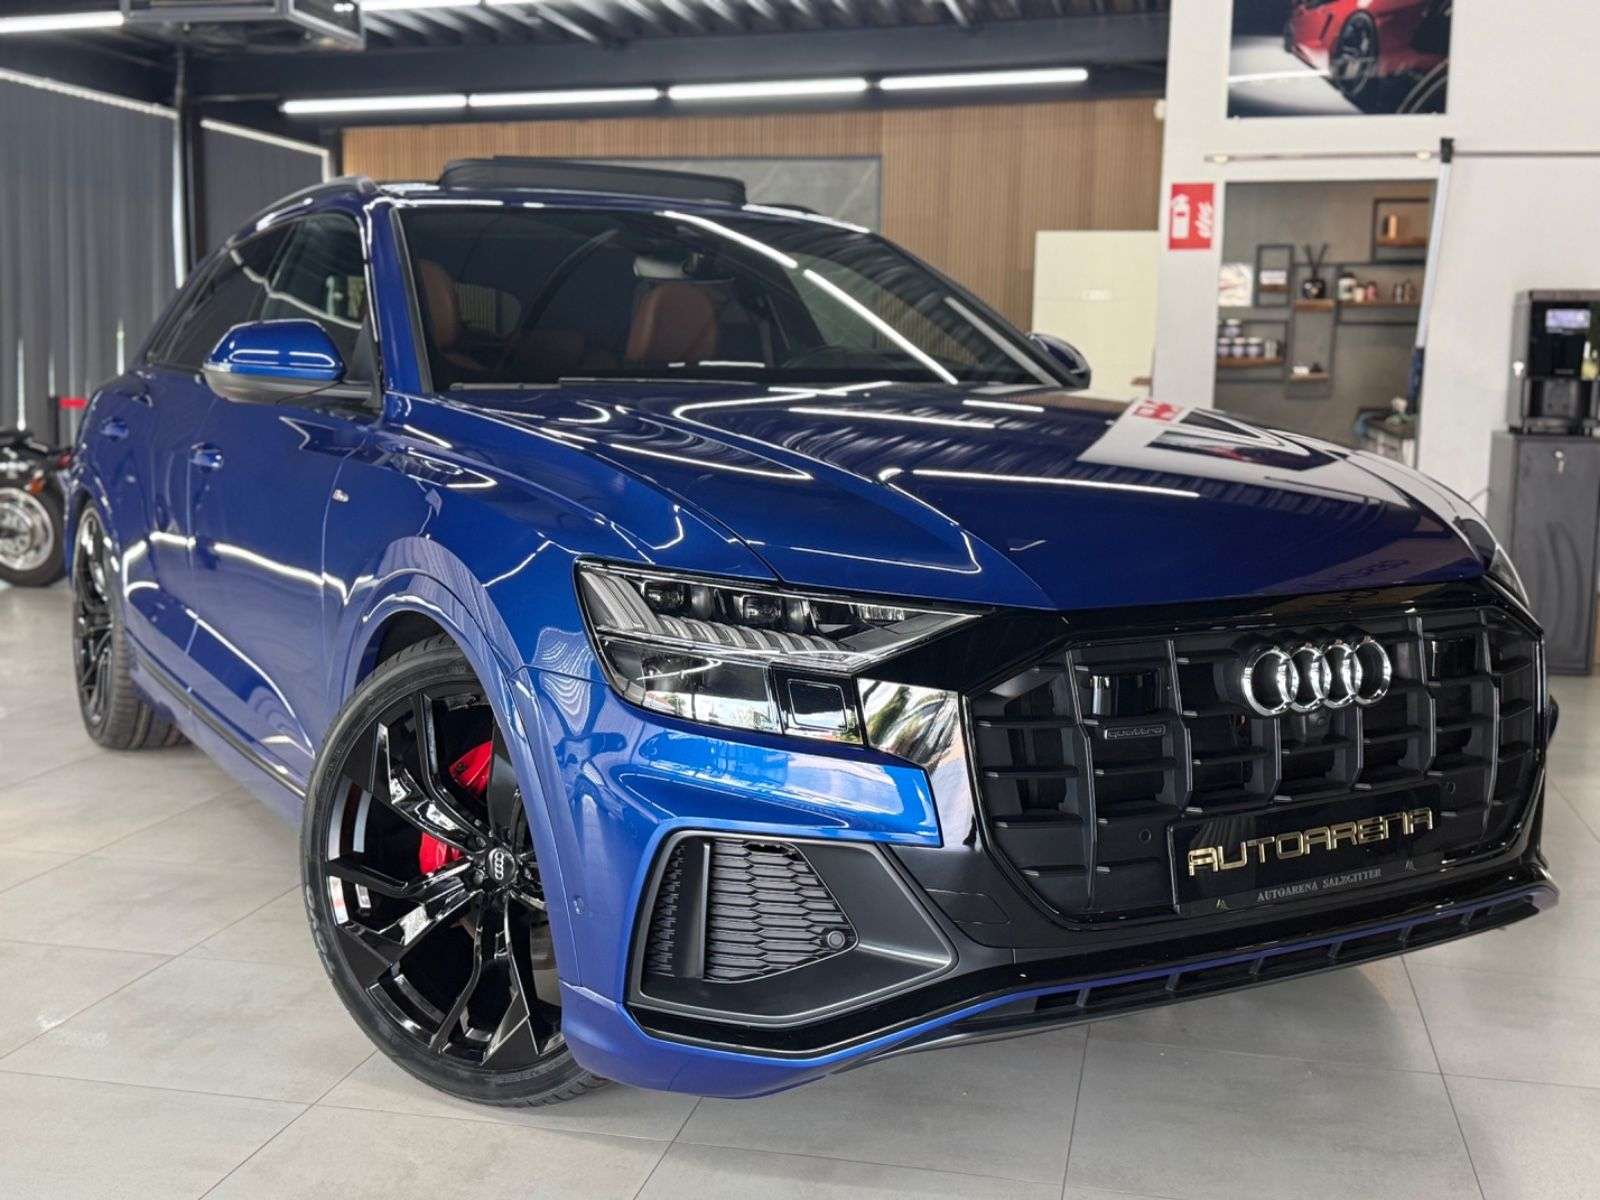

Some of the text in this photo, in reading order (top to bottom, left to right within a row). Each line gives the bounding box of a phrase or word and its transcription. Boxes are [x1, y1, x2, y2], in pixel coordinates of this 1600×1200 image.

[1187, 807, 1434, 876] AUTOARENA
[1256, 868, 1382, 903] AUTOARENA SALZGITTER
